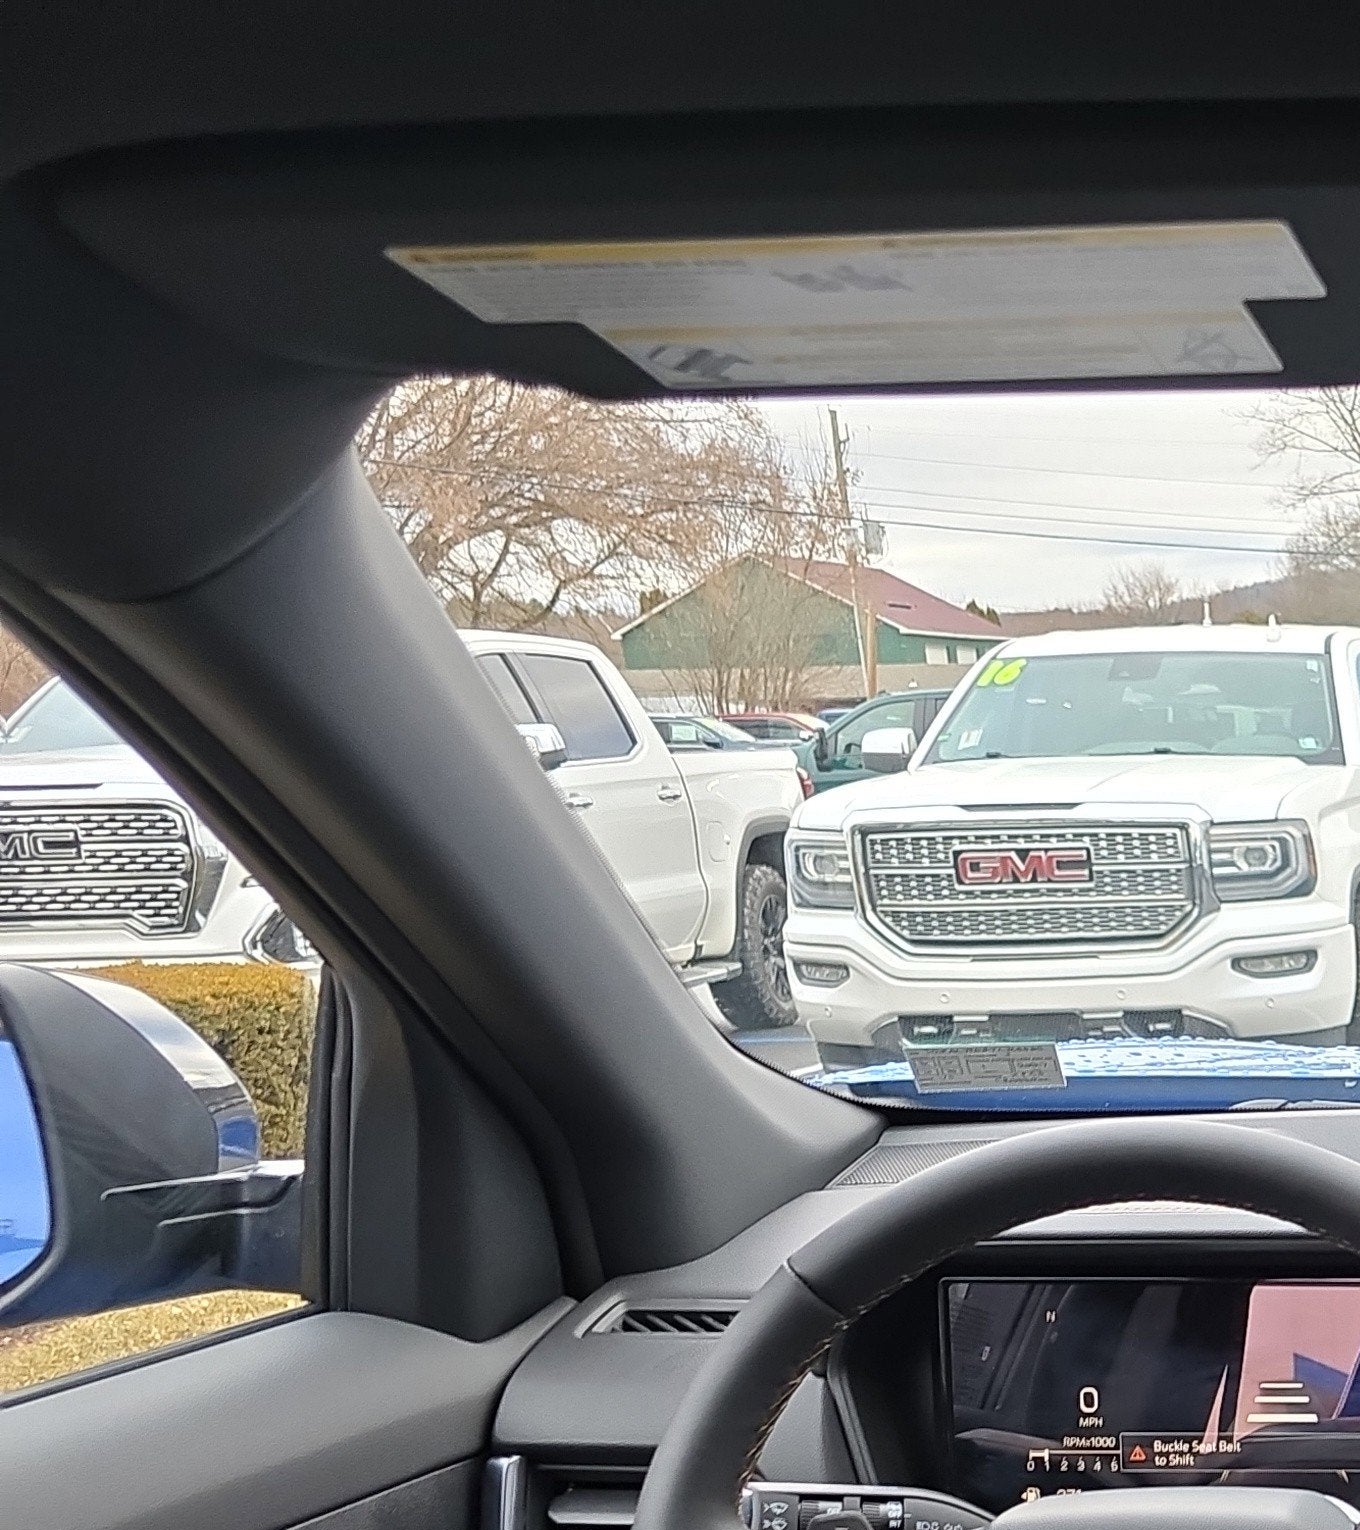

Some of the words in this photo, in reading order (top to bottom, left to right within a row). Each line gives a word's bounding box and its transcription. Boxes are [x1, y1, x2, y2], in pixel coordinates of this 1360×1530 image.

[977, 658, 1028, 687] 16
[0, 831, 79, 860] MC
[958, 850, 1089, 884] GMC
[1046, 1311, 1056, 1322] N
[1079, 1386, 1099, 1413] 0
[1079, 1417, 1103, 1428] MPH
[1153, 1440, 1189, 1452] Buckle
[1192, 1440, 1217, 1453] Seat
[1219, 1440, 1241, 1453] Belt
[1154, 1456, 1166, 1466] to
[1168, 1454, 1194, 1466] Shift
